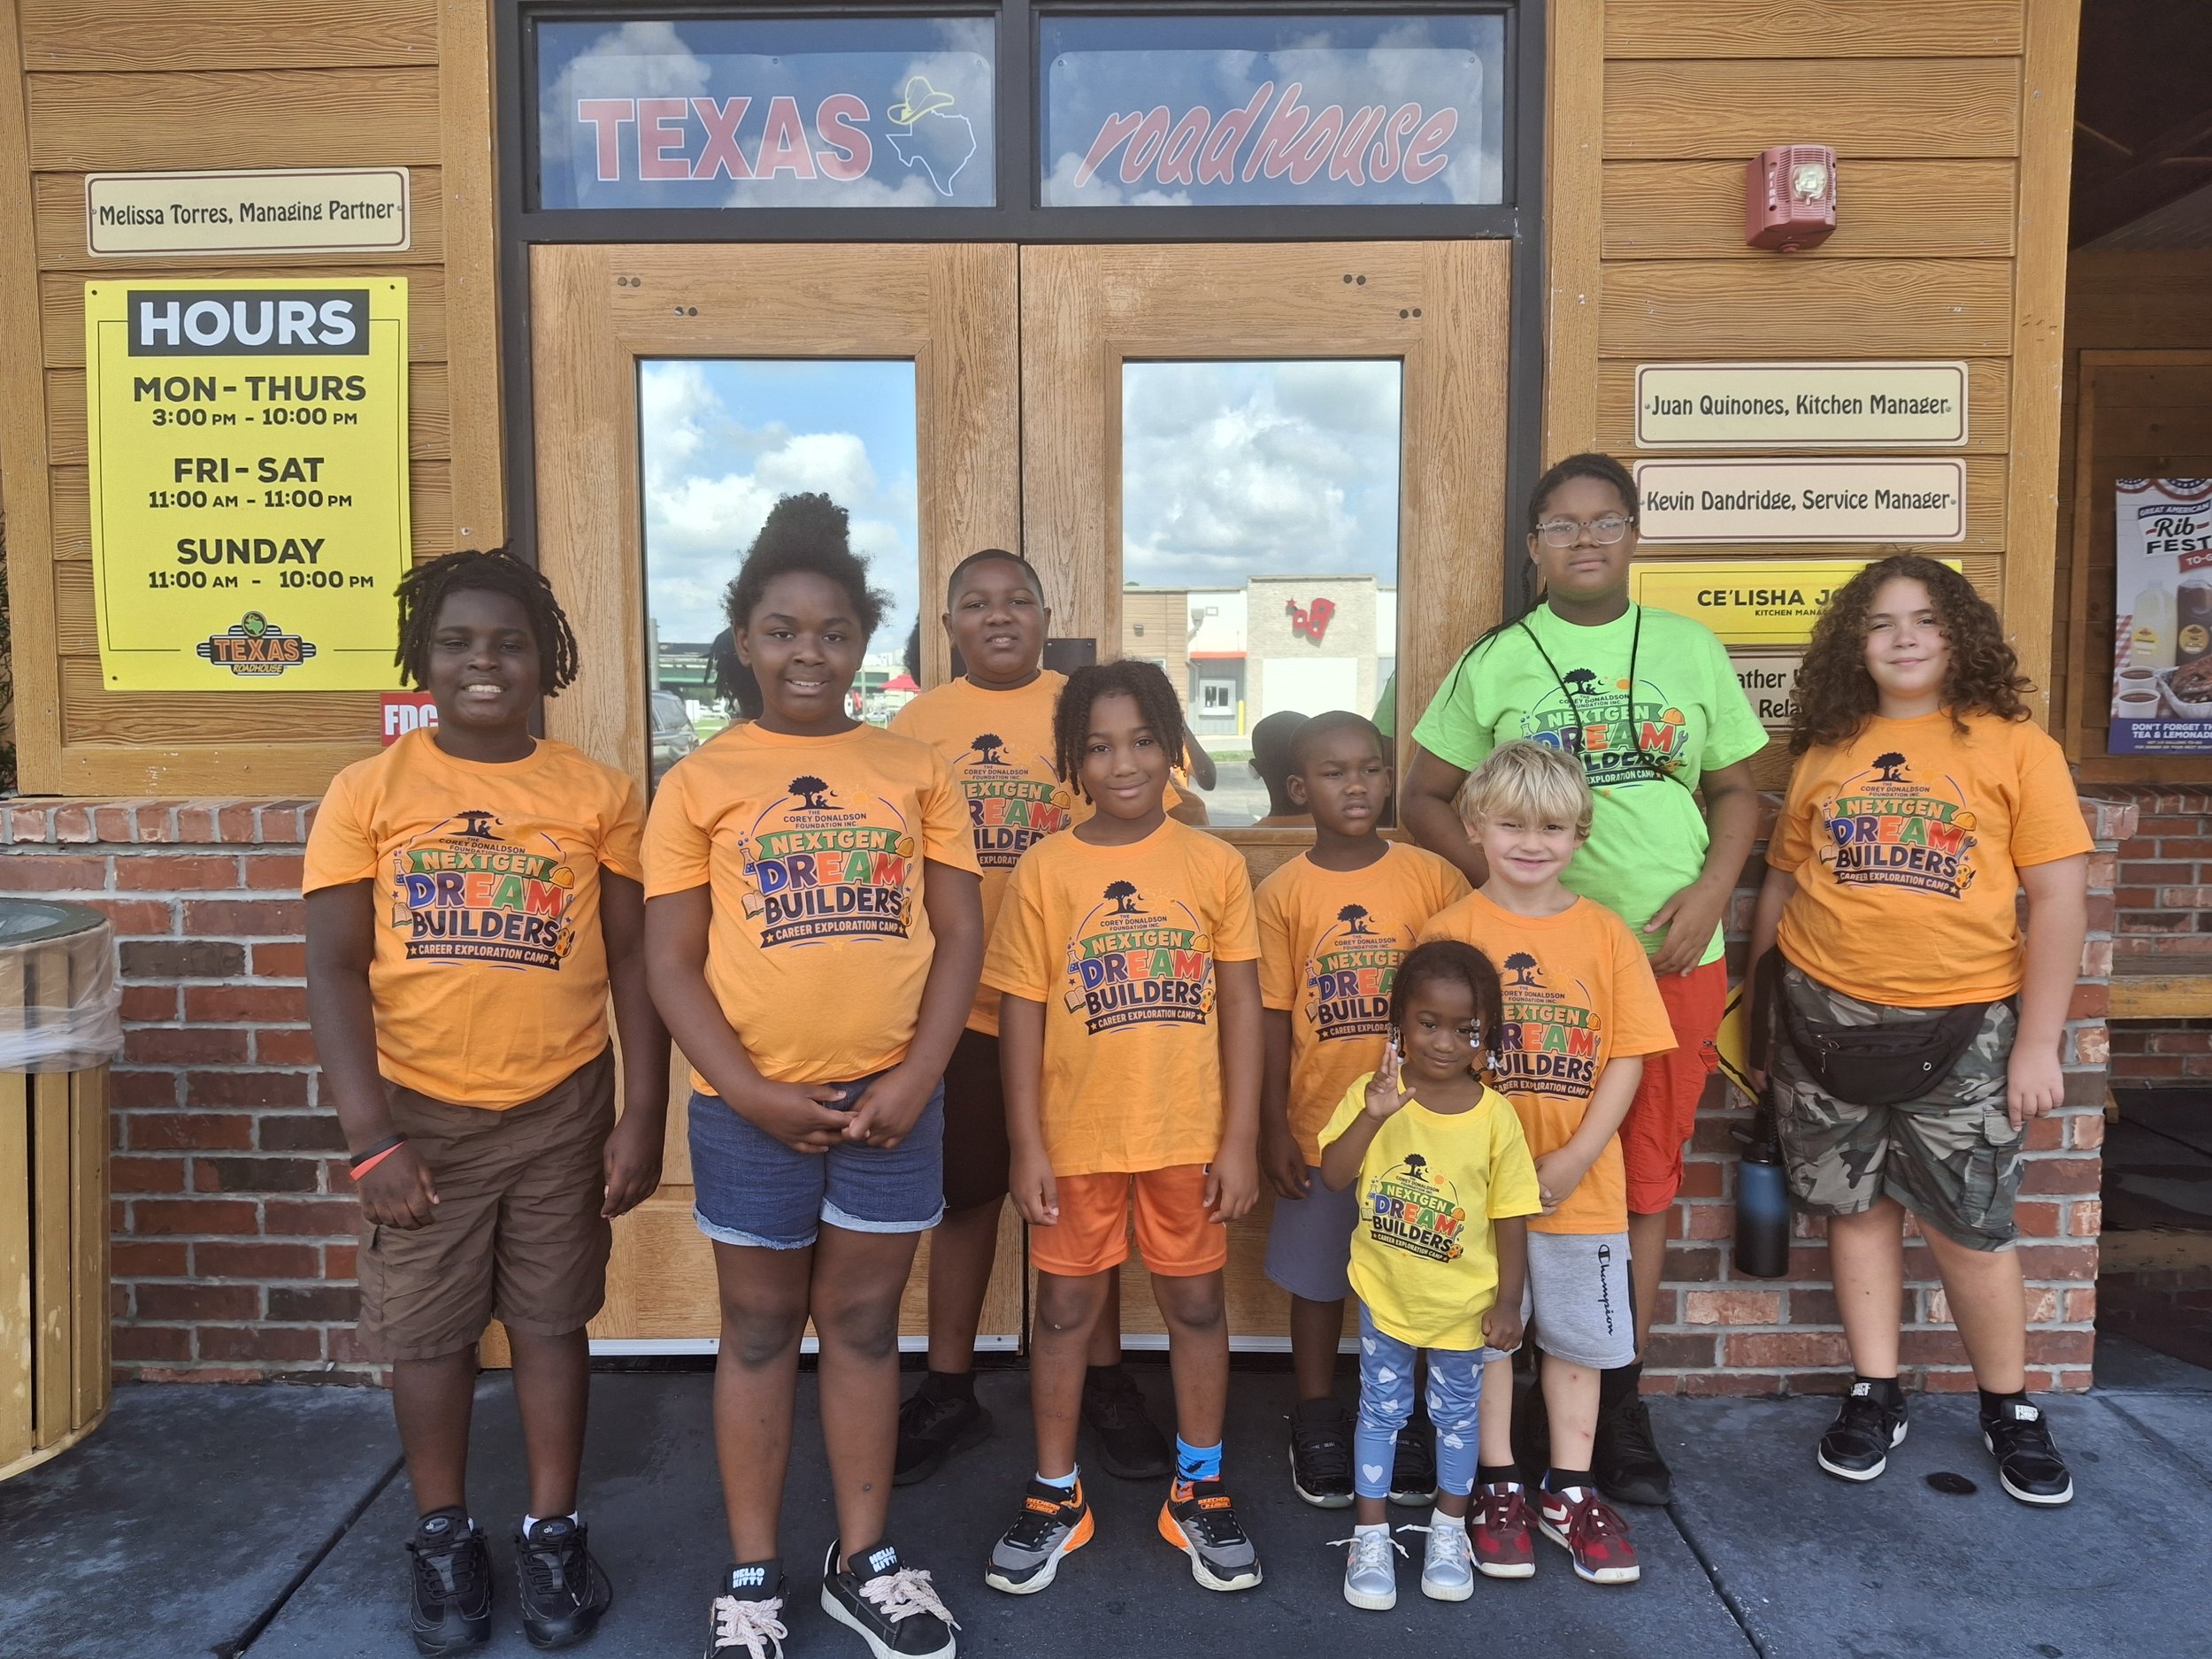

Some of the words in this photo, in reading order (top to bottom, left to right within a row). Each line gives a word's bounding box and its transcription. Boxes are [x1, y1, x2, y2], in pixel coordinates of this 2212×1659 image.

[577, 93, 872, 181] TEXAS
[1074, 81, 1458, 188] roadhouse
[99, 205, 165, 226] Melissa
[171, 204, 234, 225] Torres,
[241, 201, 323, 223] Managing
[329, 199, 395, 220] Partner
[141, 300, 357, 346] HOURS
[153, 409, 207, 426] 3:00
[212, 413, 235, 426] PM
[263, 407, 326, 426] 10:00
[334, 413, 357, 425] PM
[1651, 396, 1693, 415] Juan
[1700, 396, 1790, 417] Quinones,
[1796, 395, 1863, 414] Kitchen
[1870, 395, 1947, 414] Manager
[149, 491, 207, 509] 11:00
[213, 495, 239, 508] AM
[265, 490, 323, 508] 11:00
[328, 495, 352, 507] PM
[1647, 491, 1694, 511] Kevin
[1701, 490, 1796, 511] Dandridge,
[1802, 489, 1868, 510] Service
[1875, 489, 1950, 510] Manager
[2139, 506, 2166, 516] GREAT
[2166, 503, 2209, 513] AMERICAN
[2154, 517, 2194, 538] Rib
[177, 539, 326, 565] SUNDAY
[2147, 535, 2212, 554] FEST
[2185, 553, 2212, 565] TO-G
[149, 571, 207, 588] 11:00
[213, 575, 238, 588] AM
[280, 570, 343, 588] 10:00
[350, 575, 373, 588] PM
[214, 639, 300, 661] TEXAS
[233, 664, 283, 674] ROADHOUSE
[1737, 669, 1786, 688] ather
[1637, 770, 1655, 780] CAMP
[966, 782, 1043, 800] EXTGEN
[815, 812, 867, 822] DONALDSON
[968, 797, 1062, 833] REAM
[1847, 799, 1944, 819] NEXTGEN
[439, 838, 471, 847] COREY
[471, 841, 526, 854] DONALDSON
[771, 830, 887, 856] NEXTGEN
[1830, 815, 1966, 855] DREAM
[421, 852, 544, 878] NEXTGEN
[980, 856, 1019, 865] EXPLORAT
[1836, 846, 1958, 879] BUILDERS
[756, 850, 906, 895] DREAM
[1839, 872, 1869, 881] CAREER
[1870, 872, 1925, 886] EXPLORATION
[1926, 879, 1949, 892] CAMP
[404, 872, 563, 918] DREAM
[764, 886, 903, 927] BUILDERS
[411, 910, 560, 949] BUILDERS
[775, 927, 813, 941] CAREER
[815, 920, 877, 934] EXPLORATION
[879, 921, 898, 933] CAMP
[1125, 916, 1167, 925] DONALDSON
[419, 944, 452, 955] CAREER
[455, 944, 522, 960] EXPLORATION
[524, 952, 549, 964] CAMP
[1092, 931, 1184, 955] NEXTGEN
[1079, 948, 1203, 991] DREAM
[1317, 967, 1399, 1002] DREA
[1085, 980, 1202, 1016] BUILDERS
[1098, 1016, 1126, 1028] CAREER
[1128, 1009, 1177, 1021] EXPLORATION
[1177, 1010, 1195, 1020] CAMP
[1318, 997, 1389, 1025] BUILD
[1504, 1005, 1580, 1027] EXTGEN
[1330, 1025, 1356, 1036] CAREER
[1502, 1023, 1594, 1059] REAM
[1497, 1054, 1594, 1083] UILDERS
[1520, 1080, 1567, 1093] EXPLORATION
[1568, 1086, 1586, 1095] CAMP
[1386, 1186, 1448, 1212] NEXTGEN
[1374, 1194, 1459, 1237] DREAM
[1372, 1216, 1453, 1252] BUILDERS
[1378, 1233, 1395, 1245] CAREER
[1395, 1238, 1429, 1256] EXPLORATION
[1429, 1250, 1443, 1260] CAMP
[1598, 1244, 1614, 1336] Champion
[869, 1546, 895, 1565] HELLO
[872, 1555, 897, 1572] KITTY
[733, 1567, 764, 1579] HELLO
[733, 1577, 764, 1589] KITTY
